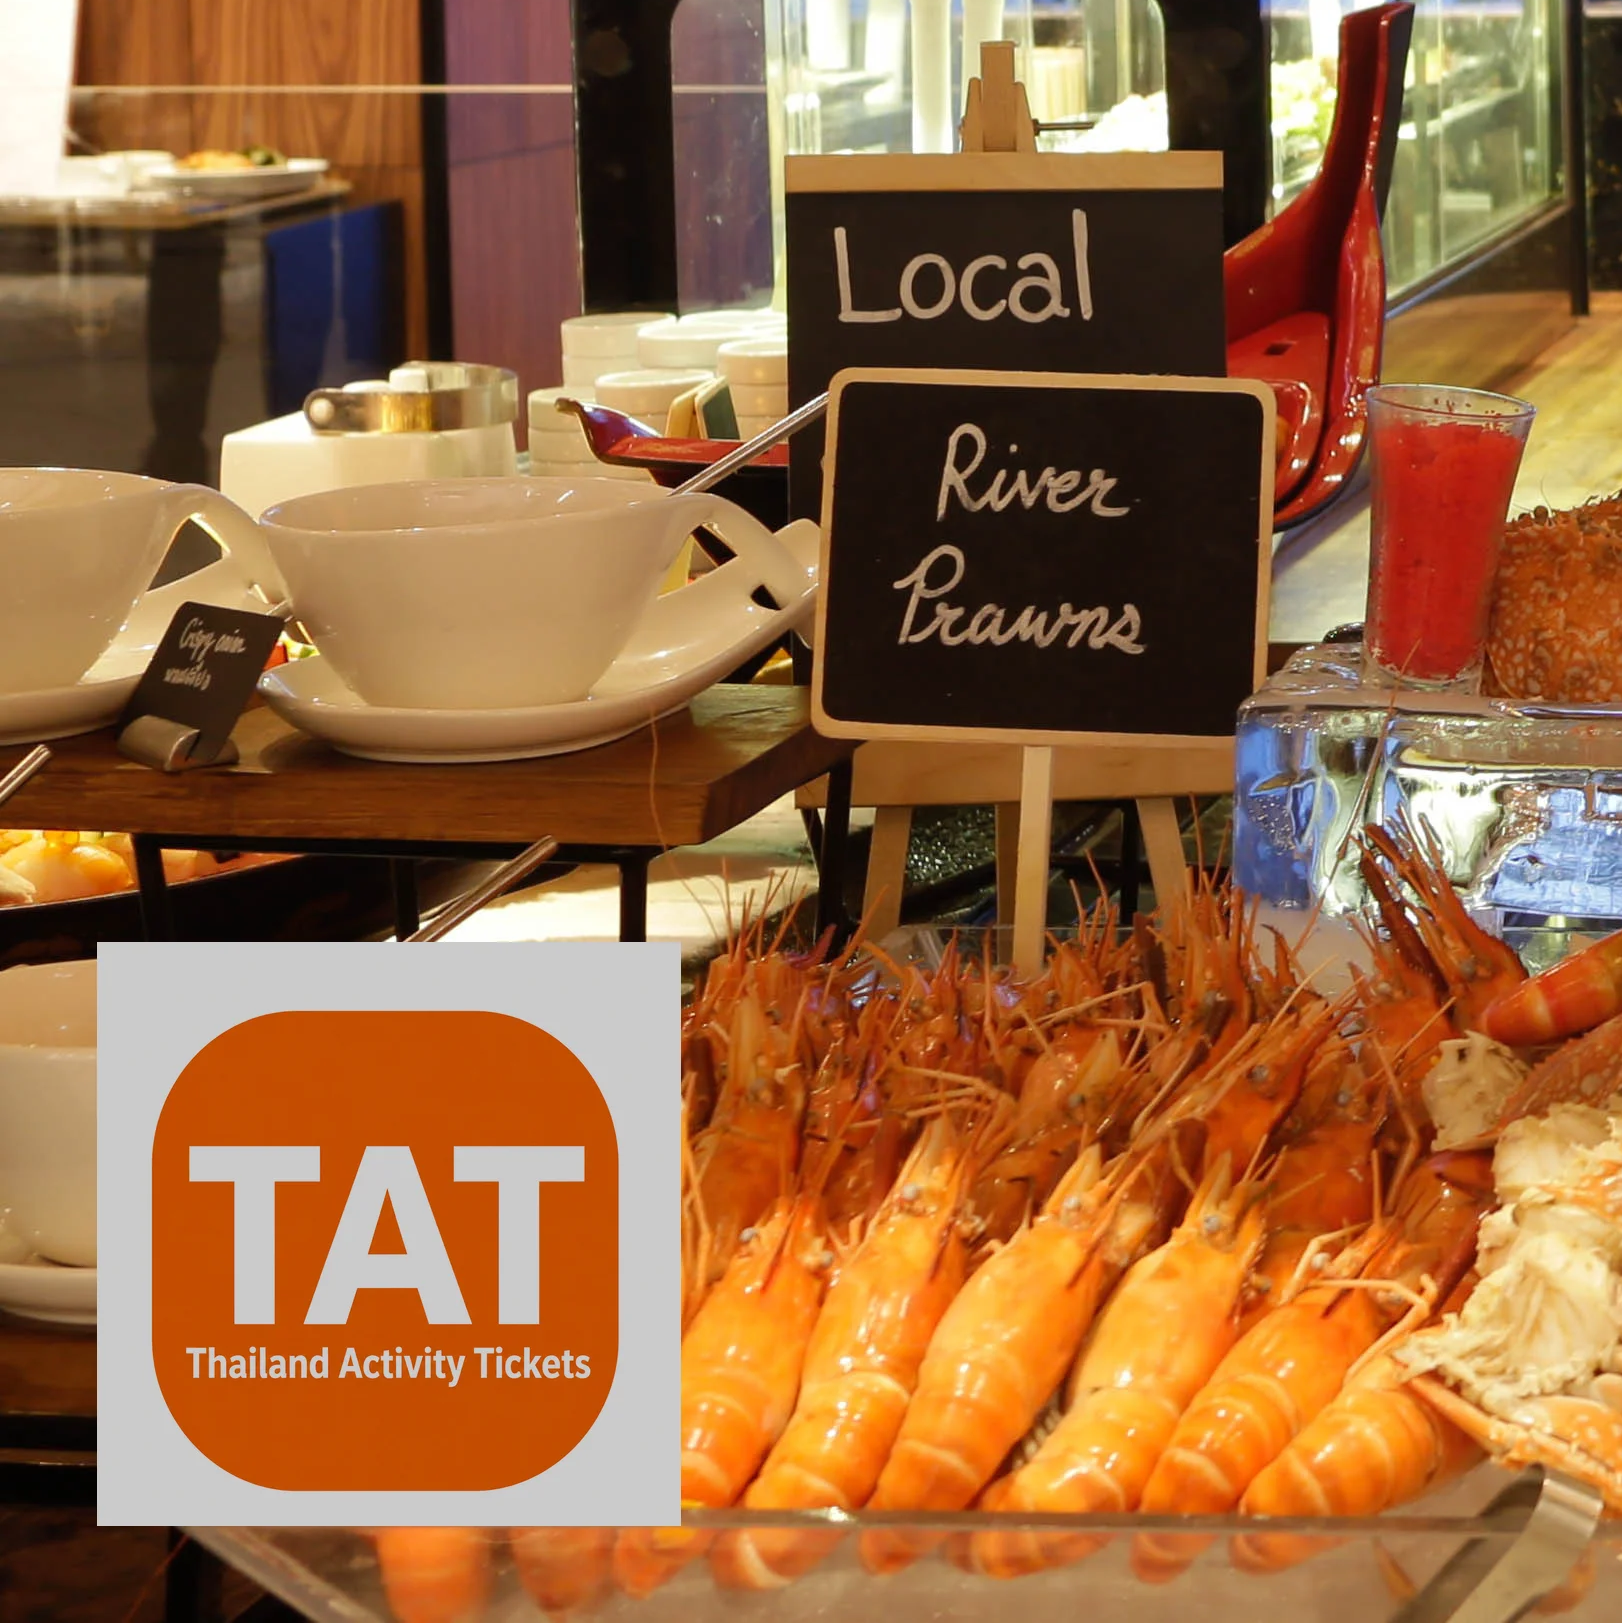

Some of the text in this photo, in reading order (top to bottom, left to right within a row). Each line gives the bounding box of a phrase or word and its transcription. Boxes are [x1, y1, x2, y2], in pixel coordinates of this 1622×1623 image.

[834, 209, 1092, 322] Local
[937, 423, 1130, 521] River
[893, 545, 1146, 654] Prawns
